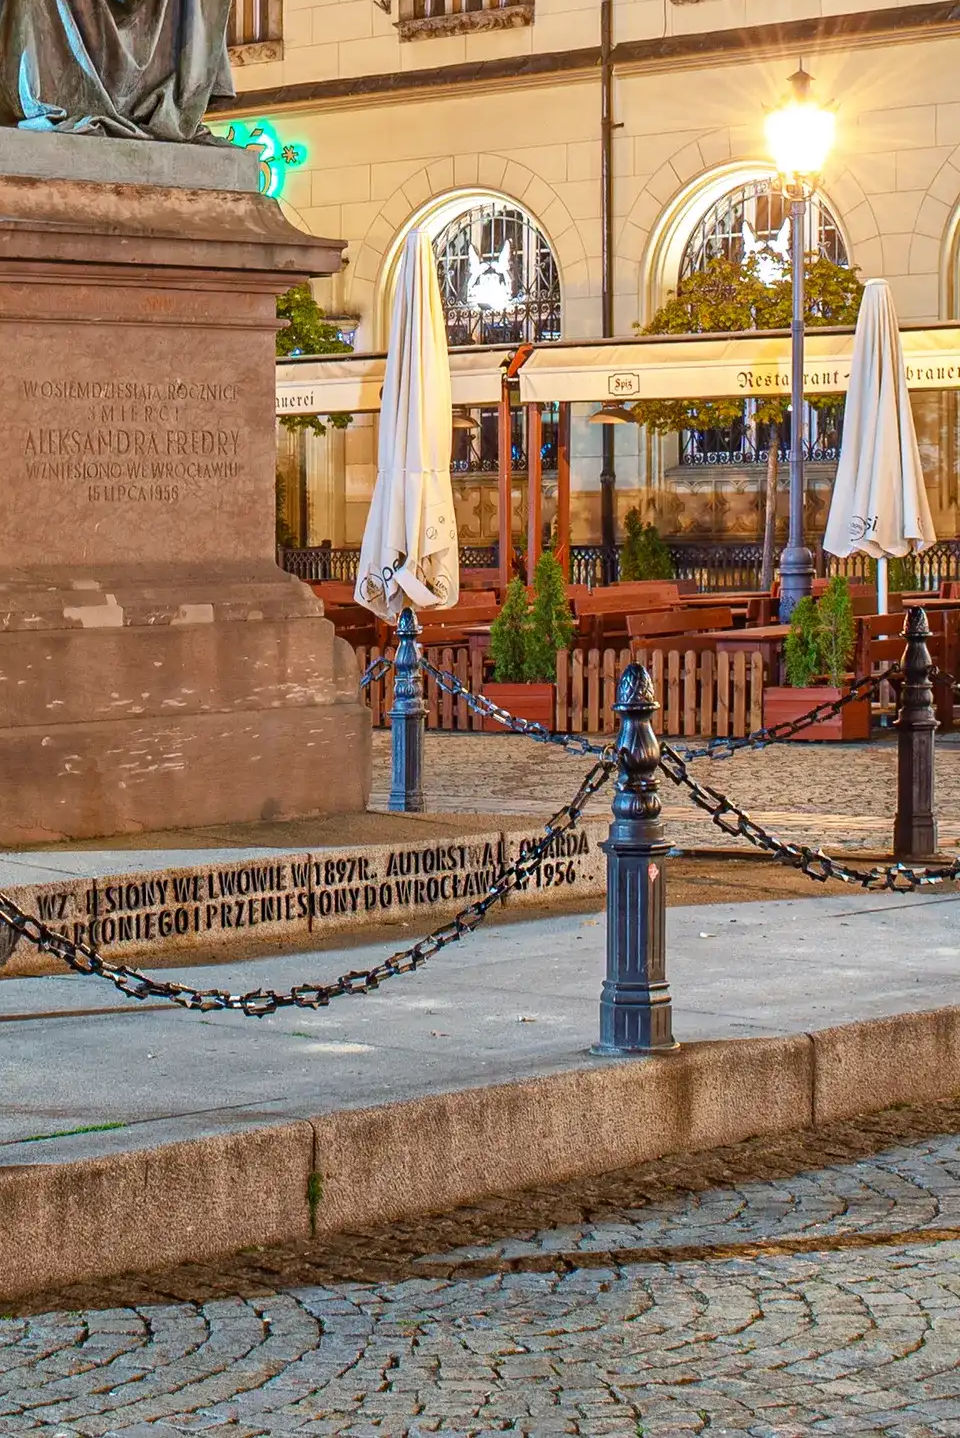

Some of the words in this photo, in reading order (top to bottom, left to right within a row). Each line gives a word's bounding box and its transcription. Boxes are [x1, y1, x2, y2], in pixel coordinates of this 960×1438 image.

[25, 429, 159, 455] ALEKSANDRA
[167, 430, 239, 455] FREDRY
[26, 462, 122, 480] WZNIESIONO
[104, 485, 147, 501] LIPCA
[37, 880, 168, 920] WZIESIONY
[208, 864, 288, 900] LWOWIE
[205, 887, 360, 930] PRZENIESIONY
[364, 881, 393, 911] DO
